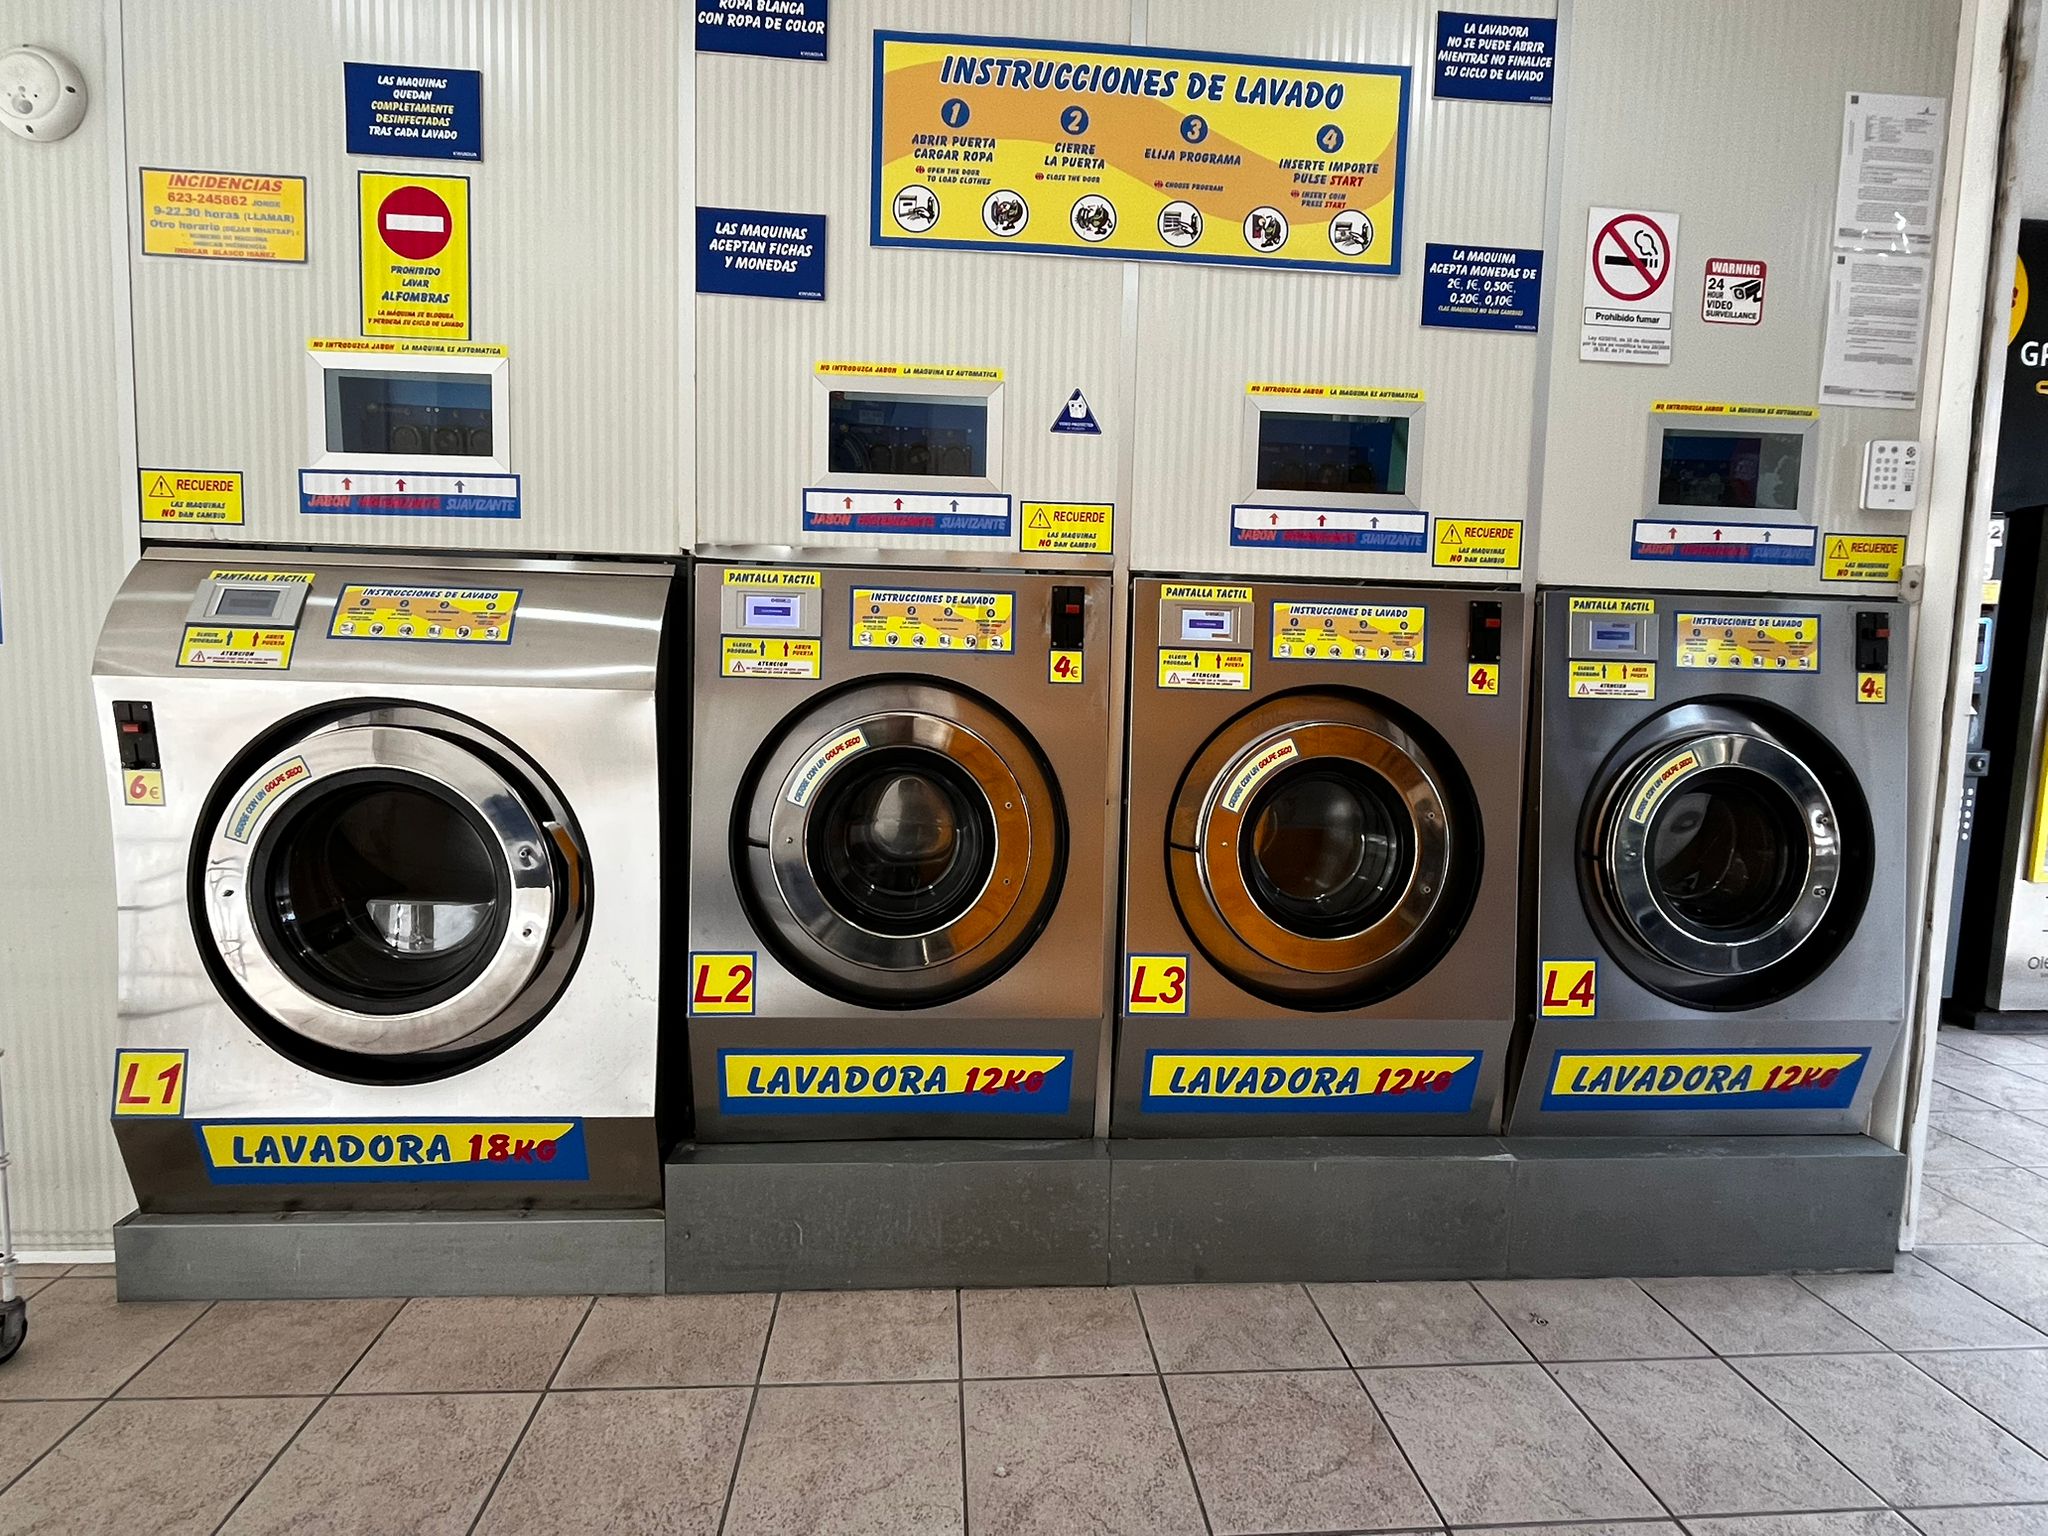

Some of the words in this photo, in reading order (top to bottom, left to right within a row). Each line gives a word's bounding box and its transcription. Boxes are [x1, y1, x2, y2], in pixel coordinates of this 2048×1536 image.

[719, 0, 752, 10] ROPA
[756, 0, 804, 15] BLANCA
[698, 12, 724, 25] CON
[727, 14, 760, 28] ROPA
[765, 17, 782, 30] DE
[786, 19, 825, 34] COLOR
[1464, 23, 1475, 34] LA
[1478, 24, 1528, 38] LAVADORA
[1447, 36, 1461, 47] NO
[1463, 38, 1476, 48] SE
[1478, 39, 1511, 51] PUEDE
[1513, 41, 1544, 53] ABRIR
[1438, 50, 1489, 64] MIENTRAS
[1491, 54, 1506, 65] NO
[1508, 56, 1552, 68] FINALICE
[1445, 66, 1458, 76] SU
[1460, 67, 1487, 78] CICLO
[1490, 69, 1503, 79] DE
[1506, 70, 1544, 82] LAVADO
[378, 75, 394, 85] LAS
[396, 77, 447, 88] MAQUINAS
[940, 55, 1179, 98] INSTRUCCIONES
[1187, 72, 1226, 101] DE
[1234, 76, 1344, 110] LAVADO
[393, 90, 432, 100] QUEDAN
[371, 101, 454, 114] COMPLETAMENTE
[950, 103, 960, 123] 1
[376, 114, 450, 126] DESINFECTADAS
[1067, 111, 1082, 131] 2
[369, 126, 392, 136] TRAS
[394, 128, 418, 137] CADA
[422, 129, 457, 140] LAVADO
[1187, 118, 1202, 140] 3
[912, 134, 948, 146] ABRIR
[952, 136, 996, 149] PUERTA
[1322, 128, 1337, 149] 4
[1055, 142, 1096, 154] CIERRE
[914, 149, 958, 161] CARGAR
[963, 151, 994, 162] ROPA
[1145, 148, 1176, 161] ELIJA
[1180, 151, 1241, 165] PROGRAMA
[1045, 156, 1058, 167] LA
[1062, 157, 1105, 170] PUERTA
[1279, 158, 1324, 171] INSERTE
[1329, 162, 1378, 174] IMPORTE
[168, 174, 282, 192] INCIDENCIAS
[1293, 174, 1327, 184] PULSE
[1330, 175, 1364, 187] START
[1192, 183, 1223, 192] PROGRAM
[168, 192, 248, 206] 623-245862
[1302, 191, 1326, 199] INSERT
[205, 209, 239, 219] horas
[150, 219, 175, 228] Otro
[179, 222, 219, 231] horario
[715, 222, 738, 235] LAS
[740, 224, 808, 240] MAQUINAS
[709, 238, 766, 254] ACEPTAN
[769, 242, 813, 257] FICHAS
[1453, 250, 1464, 260] LA
[1467, 251, 1516, 264] MAQUINA
[725, 256, 733, 268] Y
[735, 257, 798, 272] MONEDAS
[1712, 262, 1760, 275] WARNING
[391, 266, 440, 276] PROHIBIDO
[1430, 263, 1467, 275] ACEPTA
[1470, 266, 1521, 279] MONEDAS
[1522, 269, 1537, 279] DE
[402, 279, 429, 288] LAVAR
[1708, 278, 1724, 290] 24
[382, 291, 450, 303] ALFOMBRAS
[1485, 295, 1512, 306] 0,10€
[1707, 300, 1732, 310] VIDEO
[1596, 312, 1634, 322] Prohibido
[1636, 315, 1660, 323] fumar
[1706, 310, 1756, 319] SURVEILLANCE
[177, 479, 233, 491] RECUERDE
[1053, 511, 1105, 522] RECUERDE
[1465, 528, 1514, 538] RECUERDE
[1851, 542, 1898, 554] RECUERDE
[729, 573, 778, 583] PANTALLA
[783, 575, 815, 584] TACTIL
[363, 588, 441, 598] INSTRUCCIONES
[871, 593, 943, 603] INSTRUCCIONES
[946, 596, 958, 604] DE
[961, 596, 995, 605] LAVADO
[1166, 588, 1212, 597] PANTALLA
[1216, 589, 1247, 598] TACTIL
[1290, 606, 1358, 616] INSTRUCCIONES
[1362, 608, 1372, 616] DE
[1375, 609, 1408, 617] LAVADO
[1574, 601, 1617, 610] PANTALLA
[1620, 602, 1649, 611] TACTIL
[1693, 617, 1755, 626] INSTRUCCIONES
[694, 964, 752, 1003] L2
[1131, 966, 1185, 1003] L3
[1543, 970, 1594, 1007] L4
[119, 1063, 181, 1104] L1
[747, 1065, 946, 1094] LAVADORA
[963, 1068, 1045, 1094] 12KG
[1169, 1067, 1359, 1094] LAVADORA
[1372, 1068, 1454, 1095] 12KG
[1570, 1066, 1752, 1092] LAVADORA
[1762, 1065, 1841, 1091] 12KG
[233, 1134, 451, 1164] LAVADORA
[468, 1134, 557, 1164] 18KG
